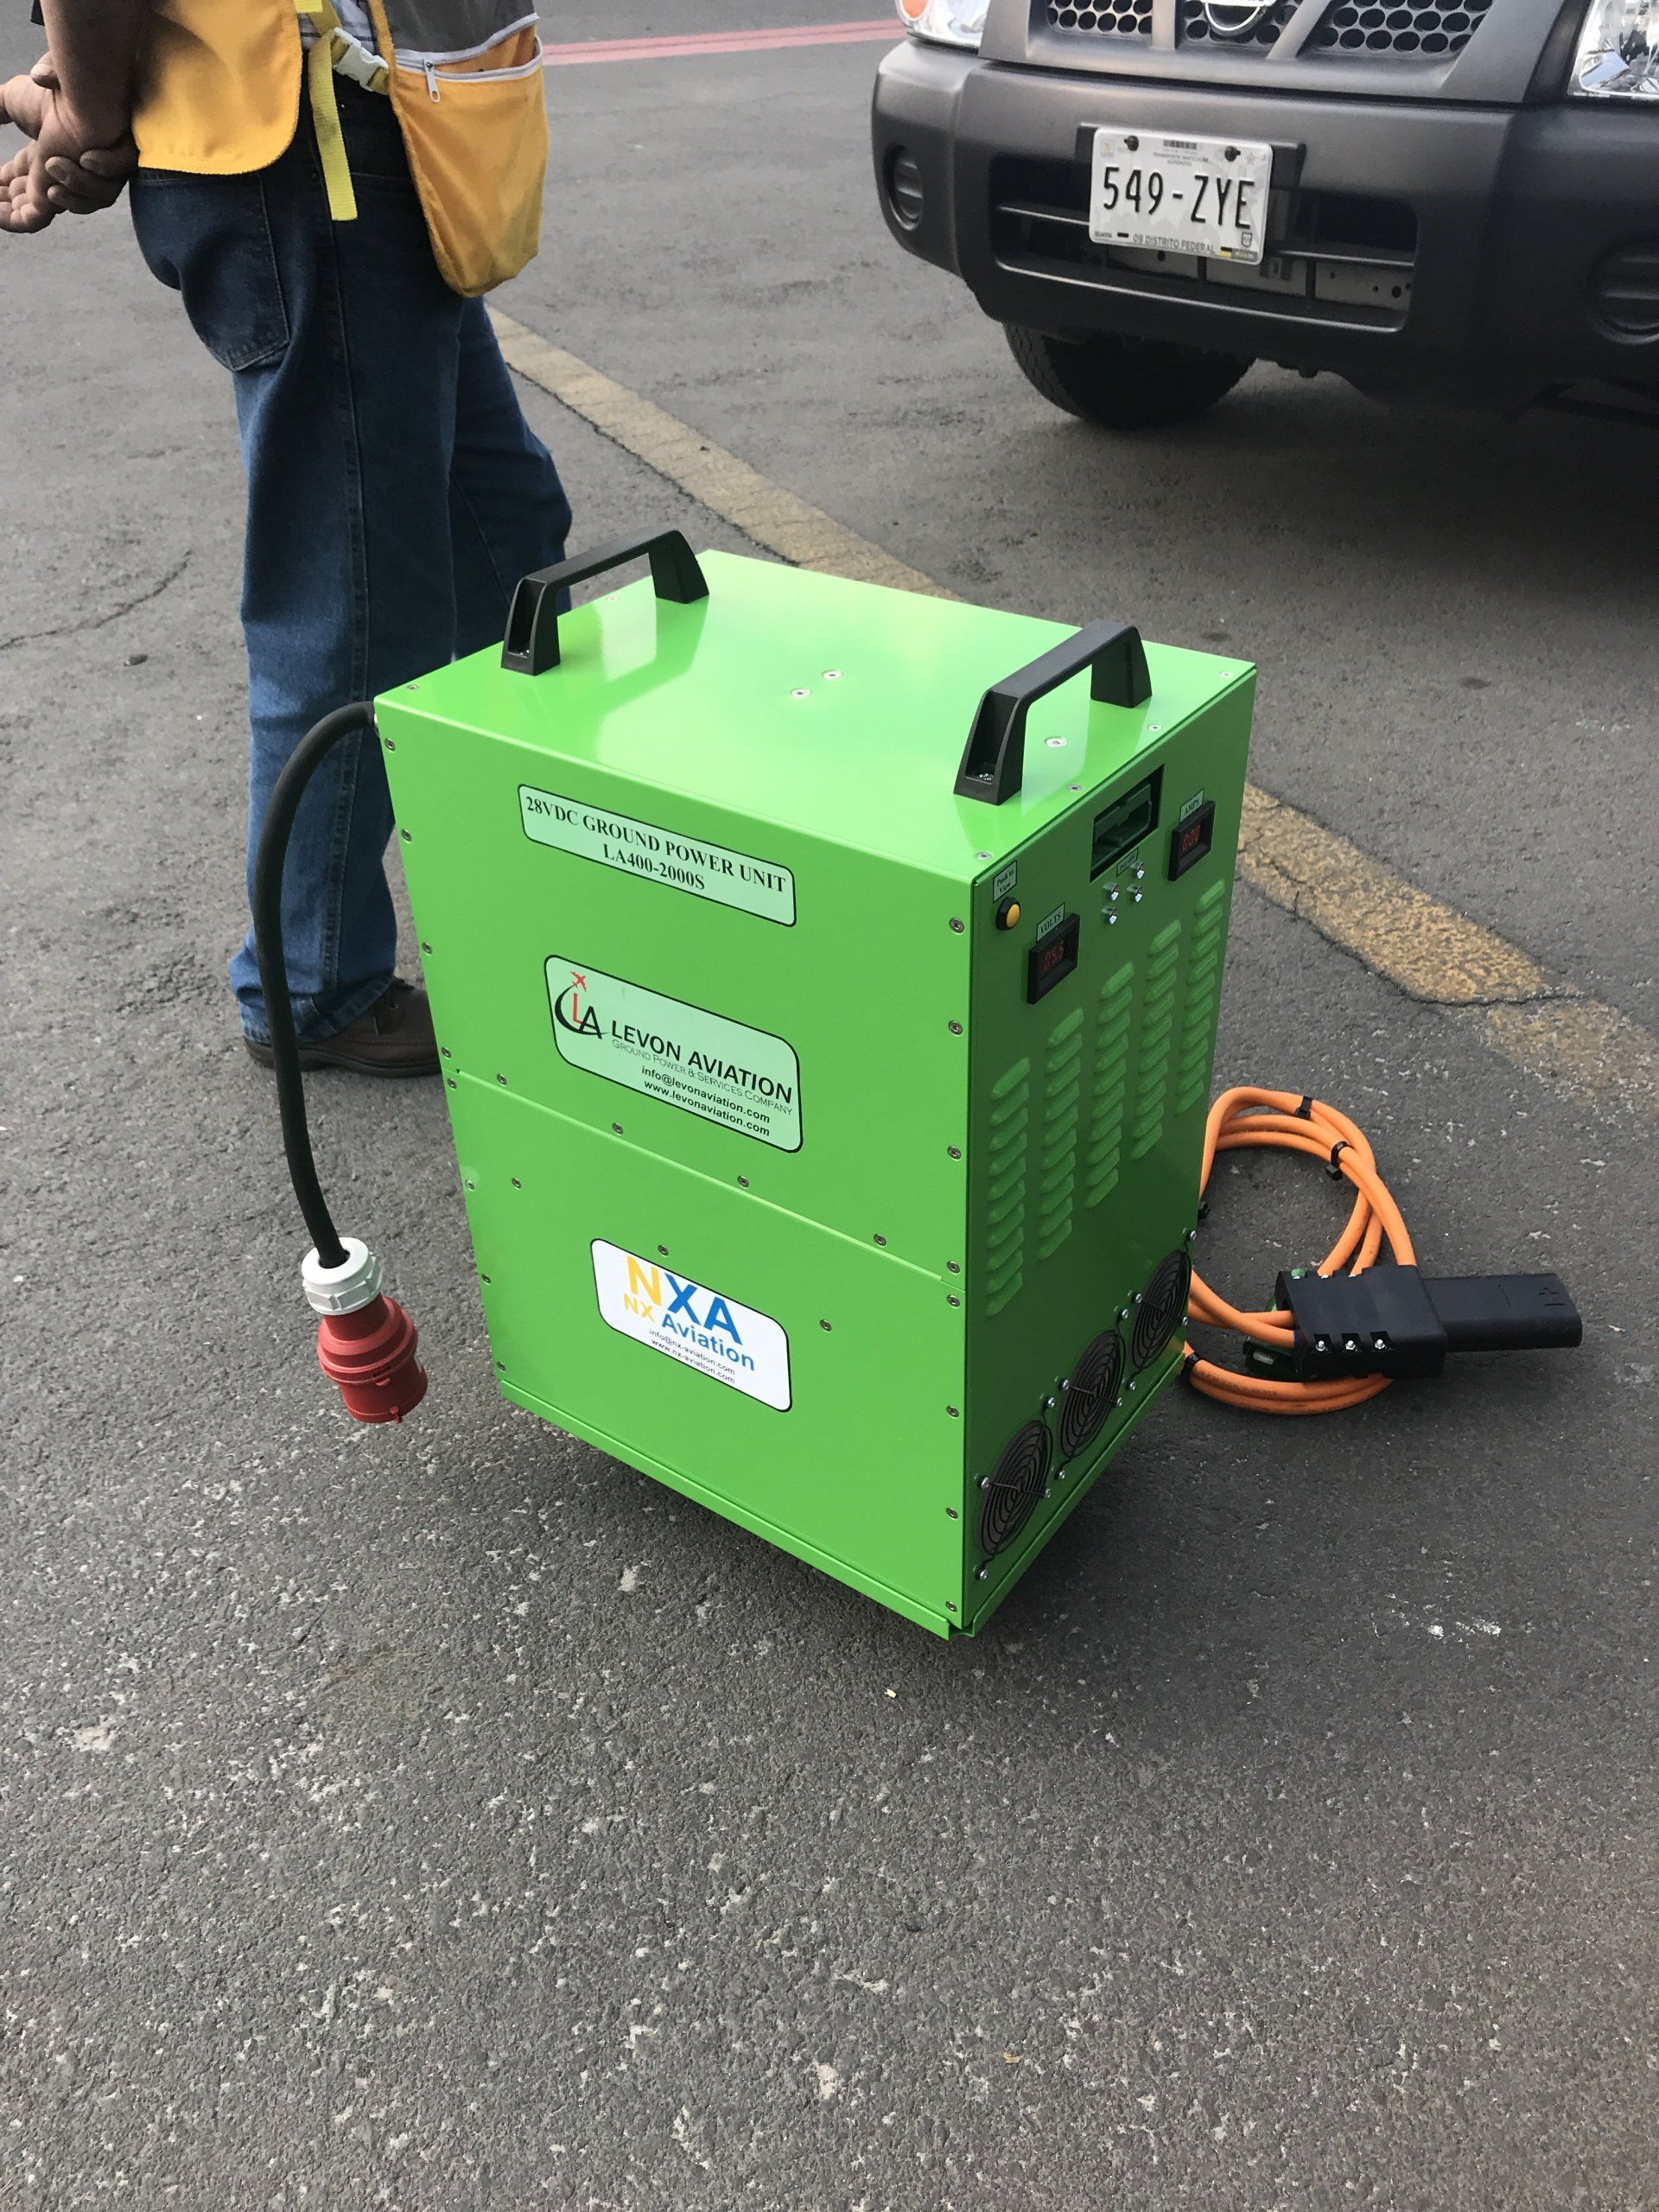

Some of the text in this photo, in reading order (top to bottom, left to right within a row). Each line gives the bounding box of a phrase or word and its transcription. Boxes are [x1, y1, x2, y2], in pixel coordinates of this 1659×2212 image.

[1103, 166, 1255, 230] 549-ZYE
[1145, 234, 1179, 247] DISTRITO
[1181, 239, 1215, 254] FEDERAL
[525, 795, 786, 893] 28VDC GROUND POWER UNIT
[602, 842, 705, 891] LA400-2000S
[1039, 912, 1062, 934] VOLTS
[611, 1020, 793, 1104] LEVON AVIATION
[612, 1039, 793, 1116] GROUND POWER & SERVICES COMPANY
[641, 1065, 771, 1124] info@levonaviation.com
[644, 1080, 771, 1137] www.levonaviation.com
[626, 1255, 743, 1346] NXA
[622, 1293, 755, 1372] NX Aviation
[649, 1328, 736, 1376] info@nx-aviation.com
[651, 1338, 736, 1384] www.nx-aviation.com
